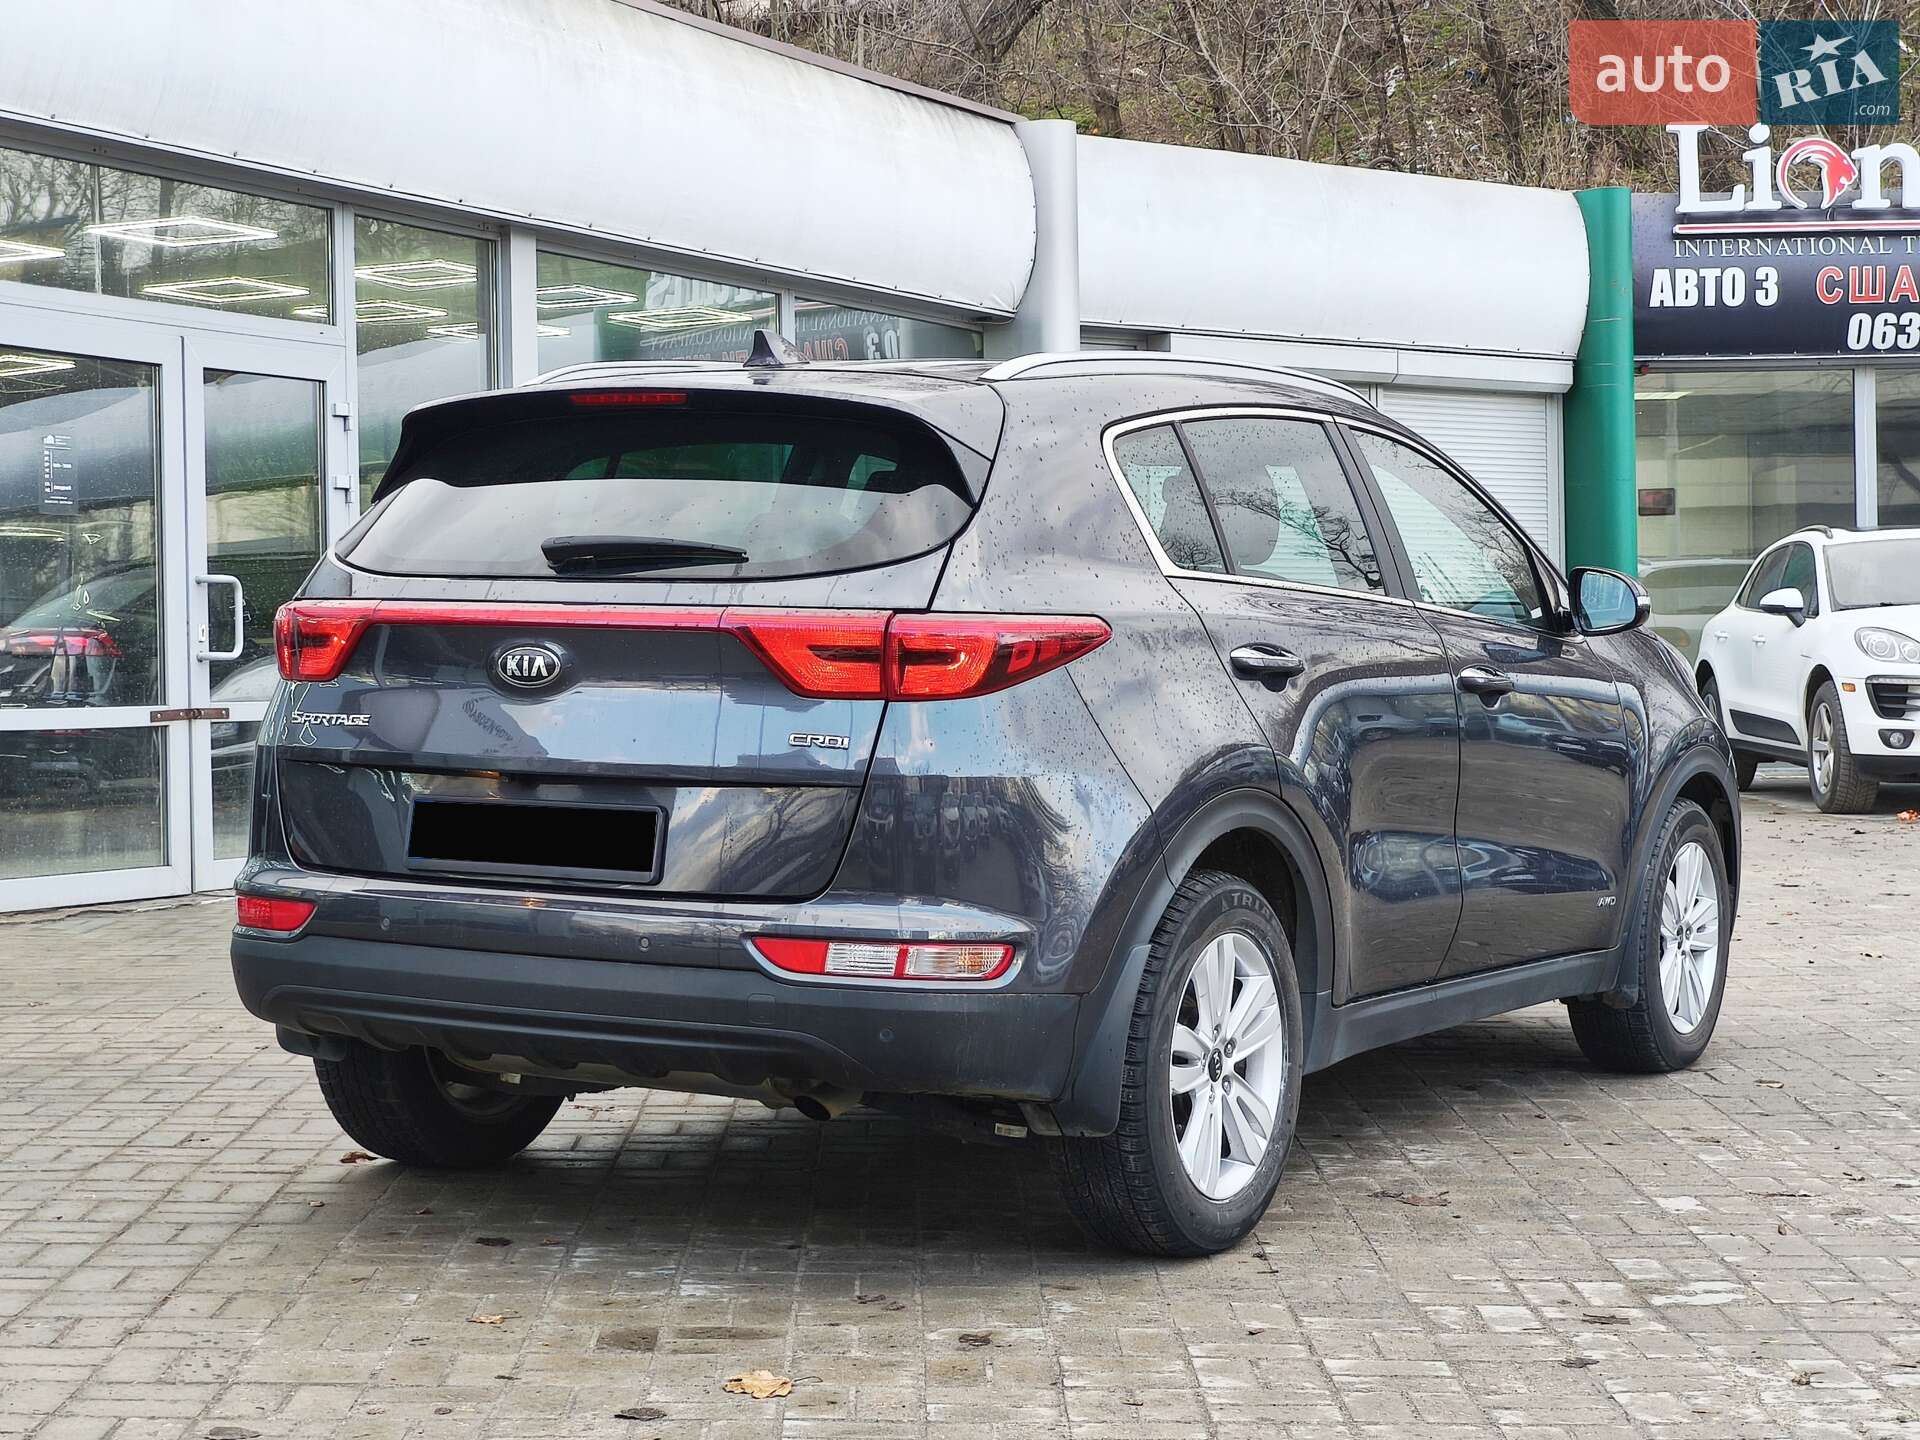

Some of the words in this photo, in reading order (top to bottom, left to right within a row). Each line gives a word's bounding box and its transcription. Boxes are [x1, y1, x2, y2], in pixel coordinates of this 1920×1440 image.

[1673, 236, 1893, 258] INTERNATIONAL
[1901, 235, 1920, 254] T
[1649, 267, 1746, 308] АВТО
[1816, 265, 1920, 305] США
[1847, 312, 1920, 350] 063
[506, 655, 548, 677] KIA
[291, 711, 371, 727] SPORTAGE
